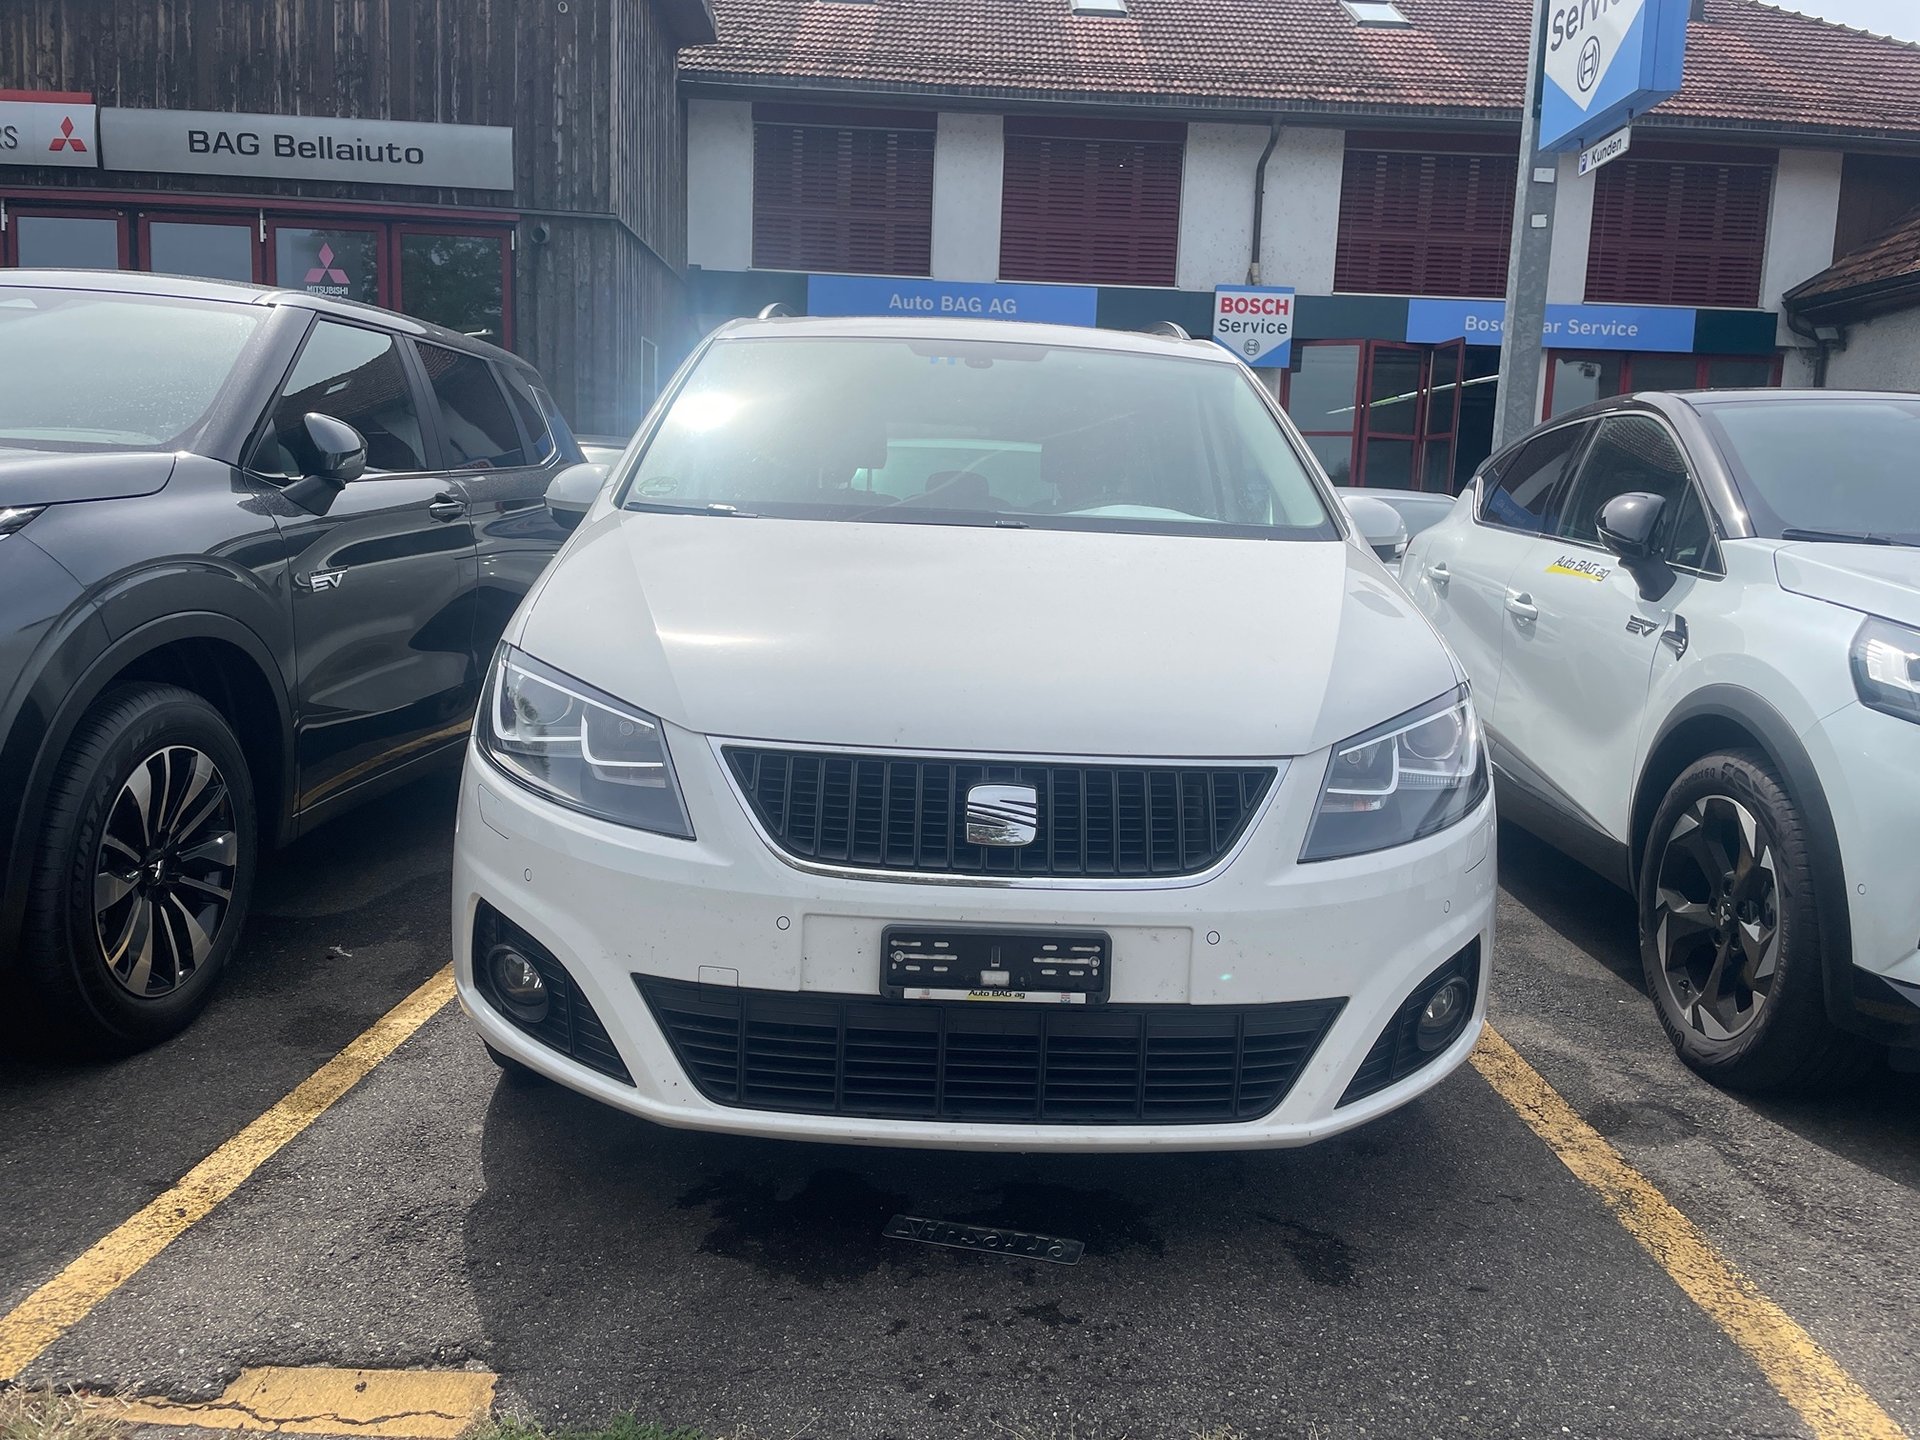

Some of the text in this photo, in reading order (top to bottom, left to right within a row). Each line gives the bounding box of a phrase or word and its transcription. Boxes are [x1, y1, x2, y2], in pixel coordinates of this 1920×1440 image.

[188, 130, 424, 165] BAG Bellaiuto
[1591, 137, 1622, 165] Kunden
[306, 285, 349, 295] MITSUBISHI
[889, 294, 1017, 314] Auto BAG AG
[1220, 297, 1289, 315] BOSCH
[1218, 318, 1288, 335] Service
[1543, 321, 1562, 334] ar
[1568, 319, 1638, 336] Service
[1553, 555, 1611, 582] Auto BAG ag
[310, 573, 343, 592] EV
[1626, 621, 1658, 637] EV
[968, 989, 990, 997] Auto
[991, 989, 1013, 998] BAG
